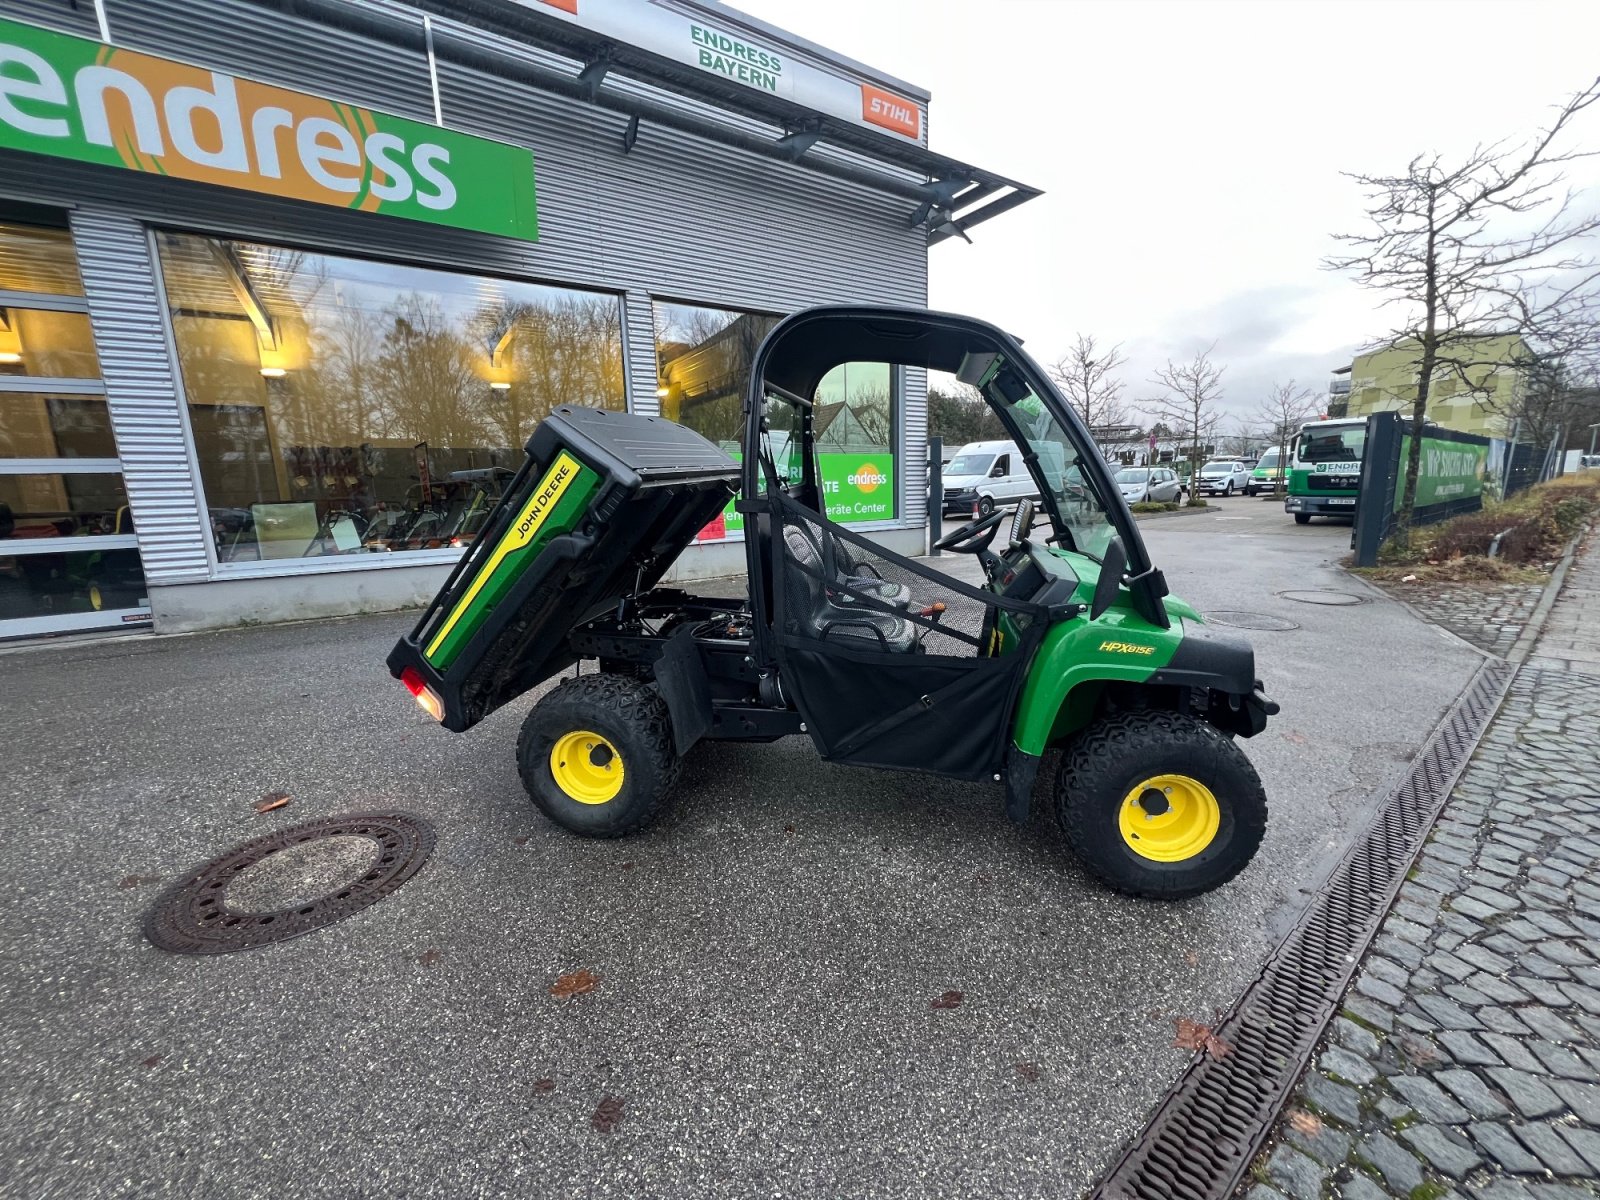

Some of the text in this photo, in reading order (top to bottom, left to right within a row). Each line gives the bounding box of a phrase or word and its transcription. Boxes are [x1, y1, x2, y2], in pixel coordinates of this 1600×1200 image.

[690, 24, 782, 72] ENDRESS
[699, 48, 776, 91] BAYERN
[0, 43, 457, 210] endress
[870, 97, 914, 126] STIHL
[847, 471, 887, 485] endress
[518, 465, 570, 539] JOHN DEERE
[826, 502, 886, 515] eräte Center
[1099, 641, 1155, 655] HPX815E
